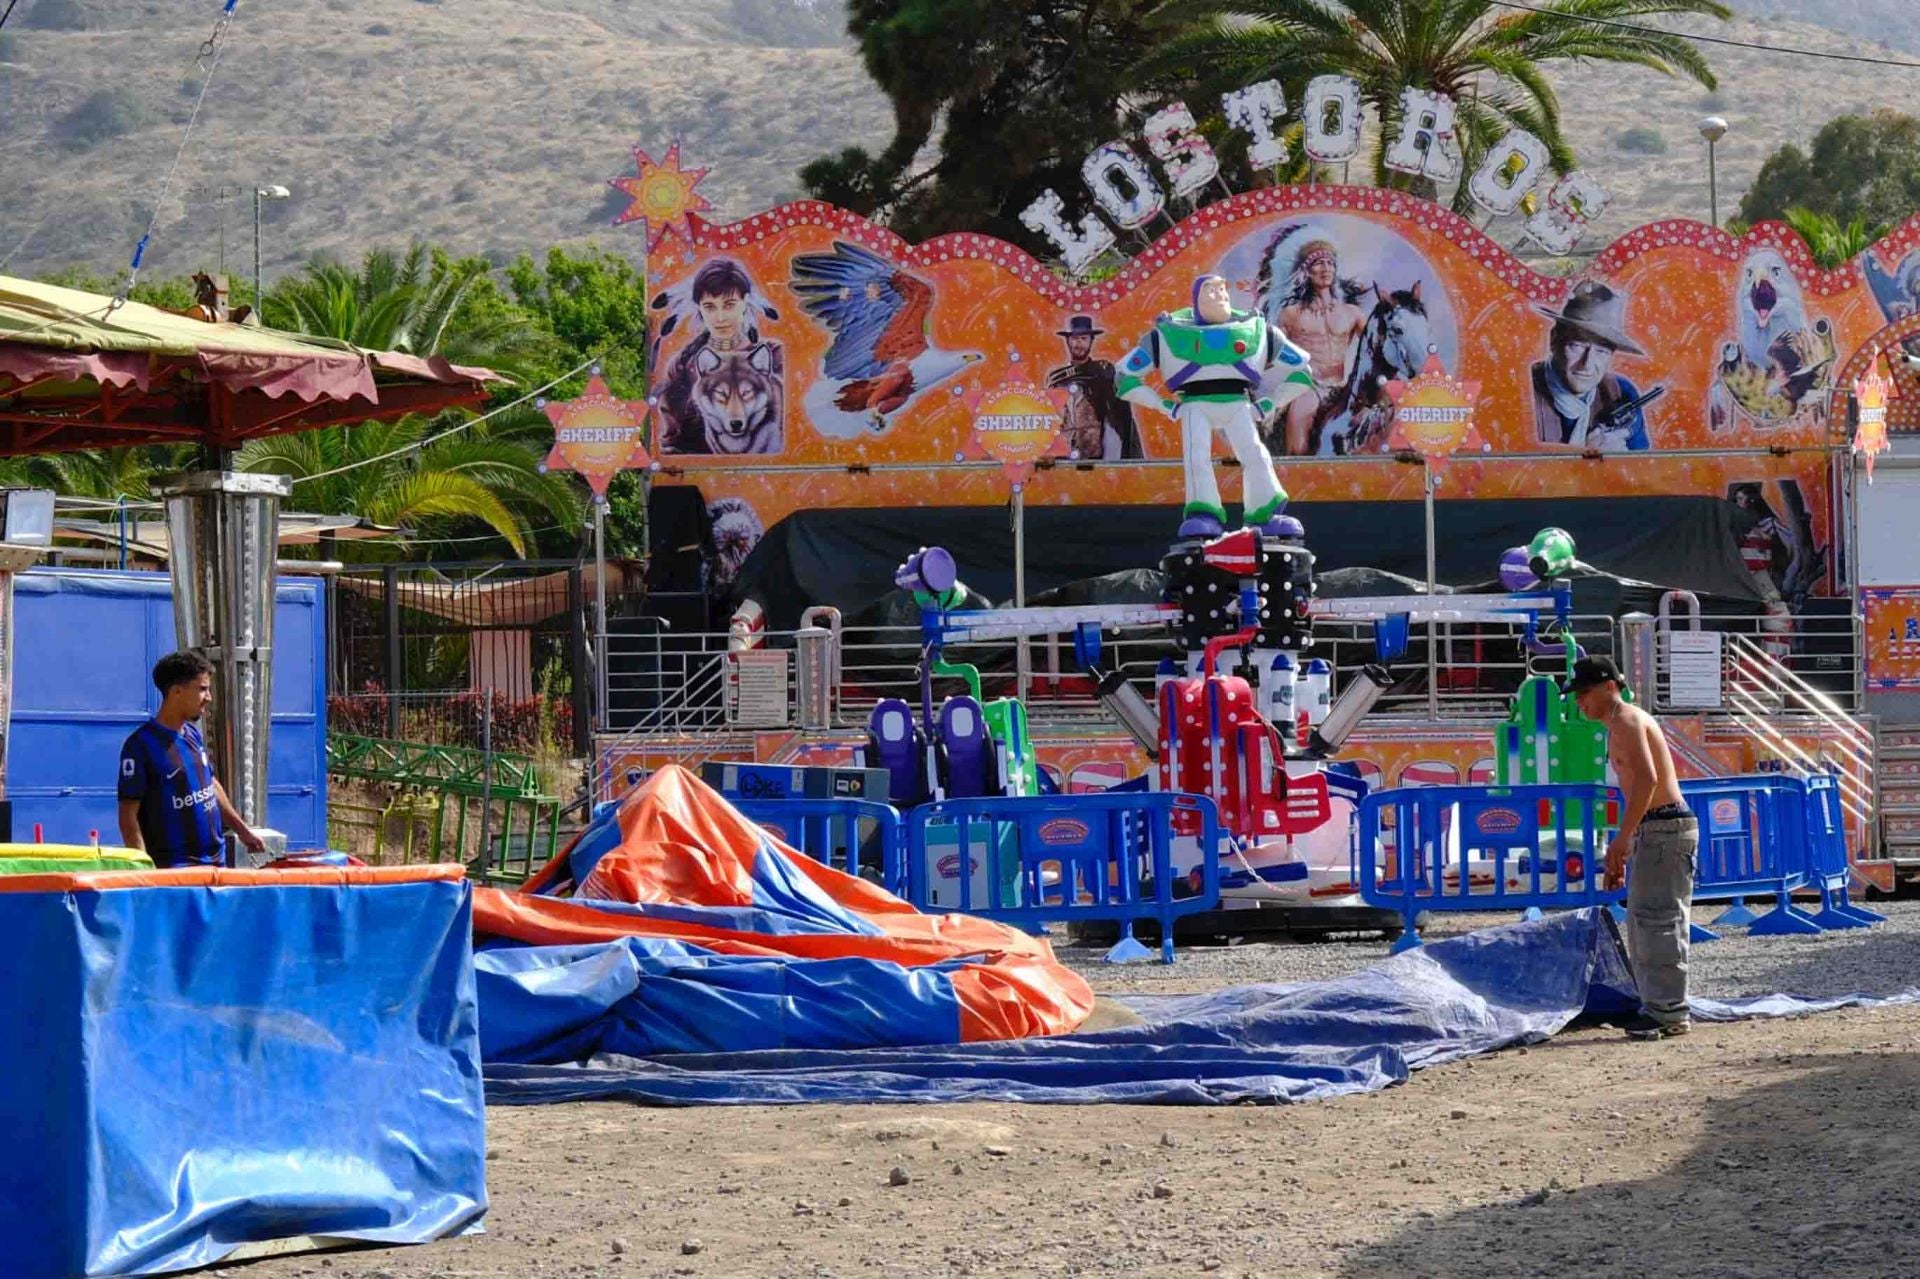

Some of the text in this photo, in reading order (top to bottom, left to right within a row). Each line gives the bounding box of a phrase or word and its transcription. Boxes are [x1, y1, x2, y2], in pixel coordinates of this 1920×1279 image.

[1018, 73, 1613, 276] LOS TOROS
[976, 414, 1053, 431] SHERIFF
[1400, 407, 1468, 422] SHERIFF
[560, 427, 635, 443] SHERIFF
